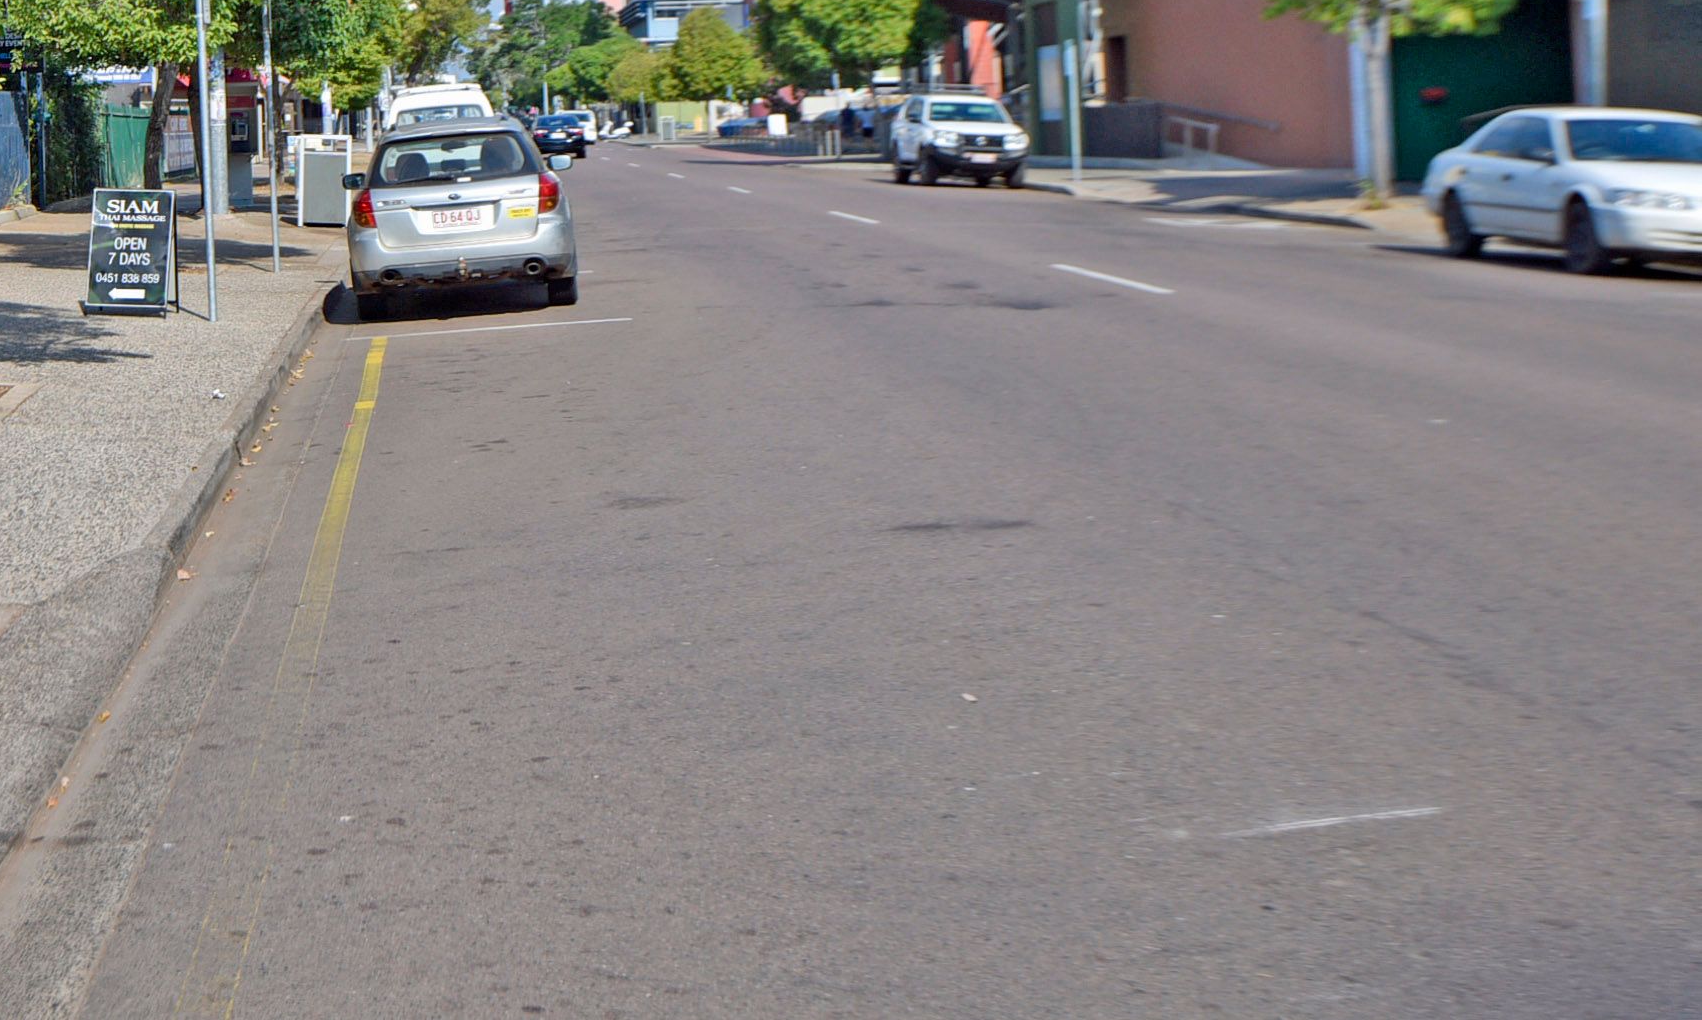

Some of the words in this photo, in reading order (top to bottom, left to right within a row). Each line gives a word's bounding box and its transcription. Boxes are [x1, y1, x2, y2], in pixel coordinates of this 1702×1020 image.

[106, 199, 159, 214] SIAM
[99, 214, 121, 222] THAI
[434, 213, 447, 223] CD
[450, 212, 463, 222] 64
[114, 237, 147, 250] OPEN
[108, 252, 117, 265] 7
[119, 252, 151, 266] DAYS
[95, 272, 118, 283] 0451
[121, 273, 140, 284] 838
[141, 273, 160, 284] 859
